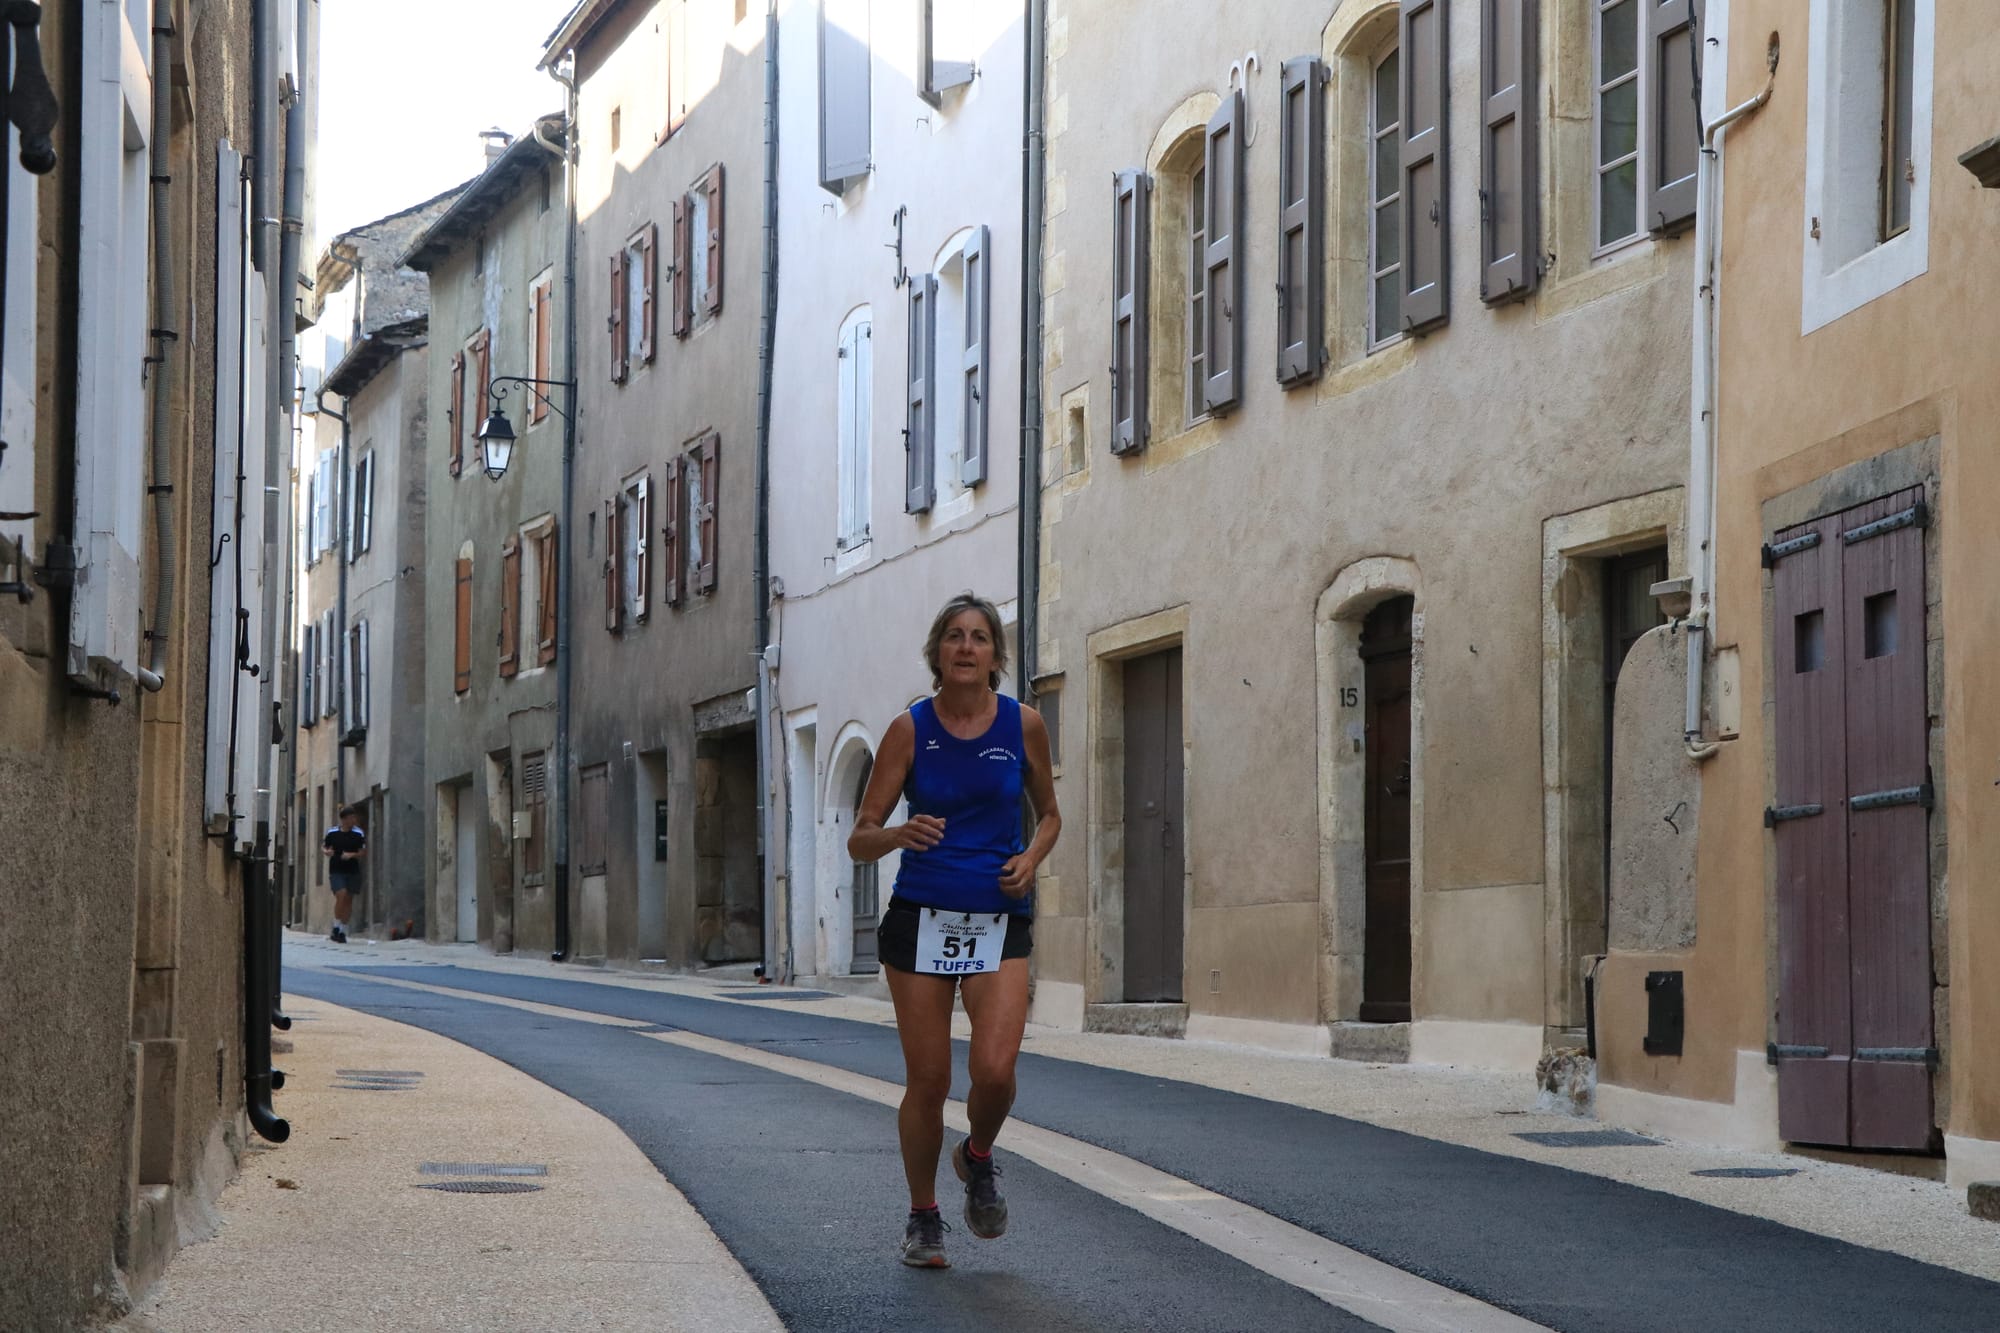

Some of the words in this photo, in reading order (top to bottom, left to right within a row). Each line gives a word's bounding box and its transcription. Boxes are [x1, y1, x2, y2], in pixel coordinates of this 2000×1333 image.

[1340, 687, 1358, 707] 15
[942, 936, 977, 958] 51
[932, 960, 985, 972] TUFF'S
